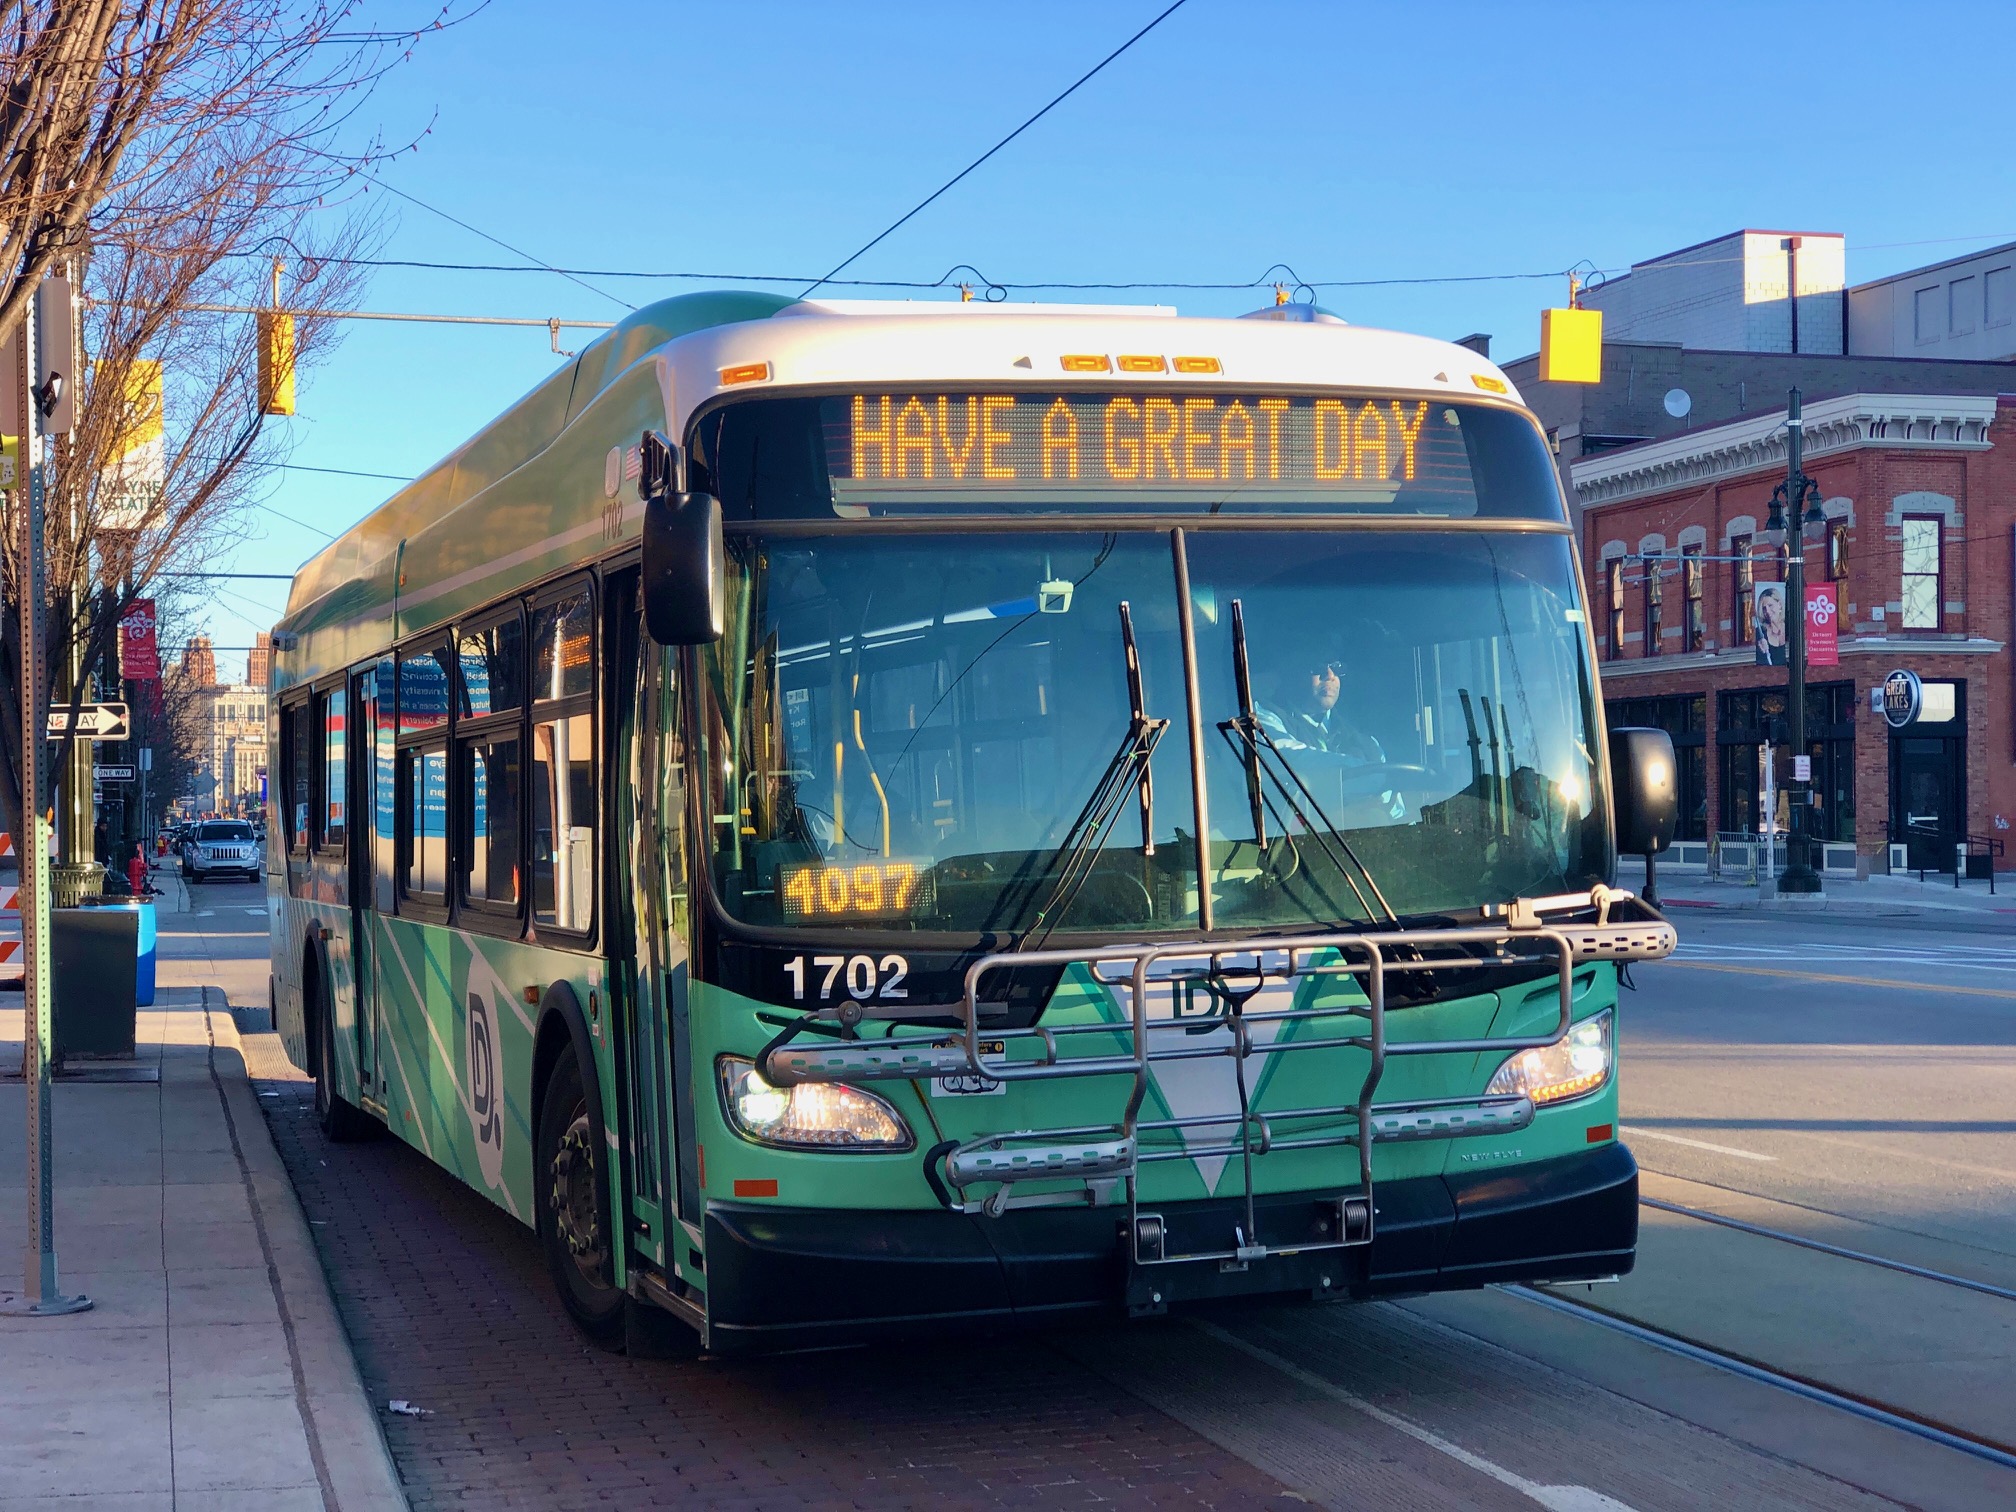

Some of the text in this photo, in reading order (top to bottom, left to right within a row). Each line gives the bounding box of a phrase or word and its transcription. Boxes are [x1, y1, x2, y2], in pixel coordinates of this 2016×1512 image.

[854, 395, 1428, 480] HAVE A GREAT DAY
[102, 480, 161, 494] WYNE
[602, 501, 623, 541] 1702
[1885, 681, 1908, 696] GREAT
[1884, 695, 1909, 709] LAKES
[114, 769, 130, 777] WAY
[786, 864, 914, 914] 4097
[783, 954, 908, 1000] 1702
[1461, 1153, 1490, 1162] NEW
